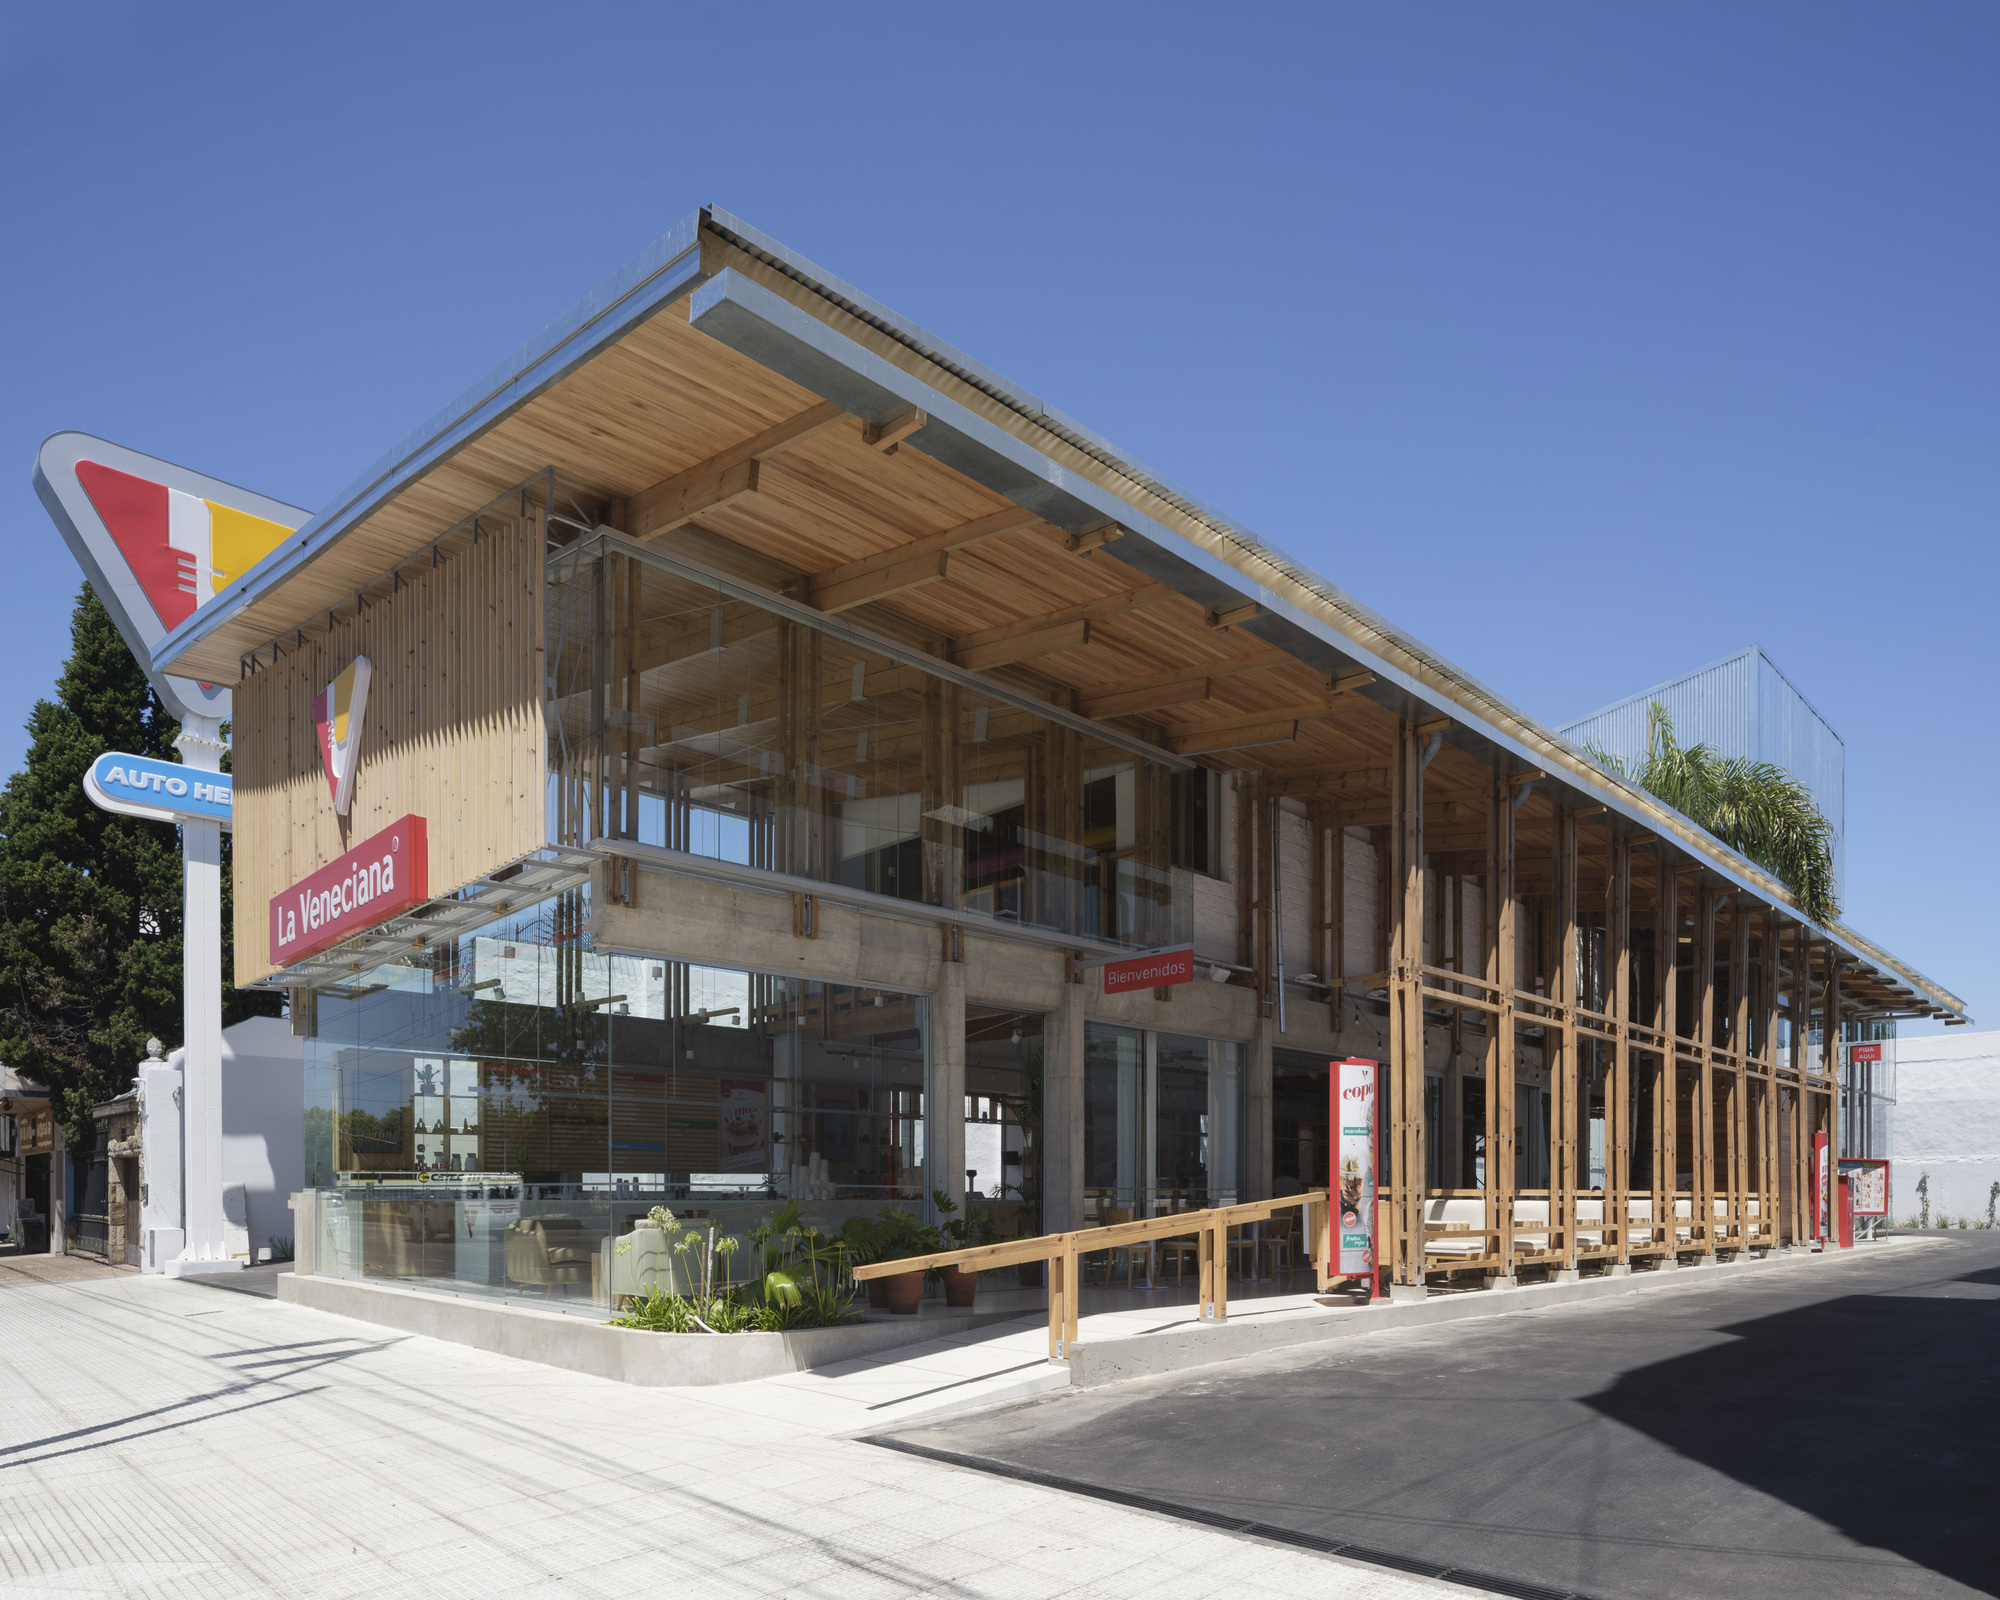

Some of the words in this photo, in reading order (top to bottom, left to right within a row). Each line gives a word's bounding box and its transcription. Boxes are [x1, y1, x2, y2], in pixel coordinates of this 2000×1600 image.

[105, 766, 188, 797] AUTO
[194, 782, 232, 806] HE
[278, 906, 296, 947] La
[300, 854, 394, 934] Veneciana
[1108, 962, 1186, 985] Bienvenidos
